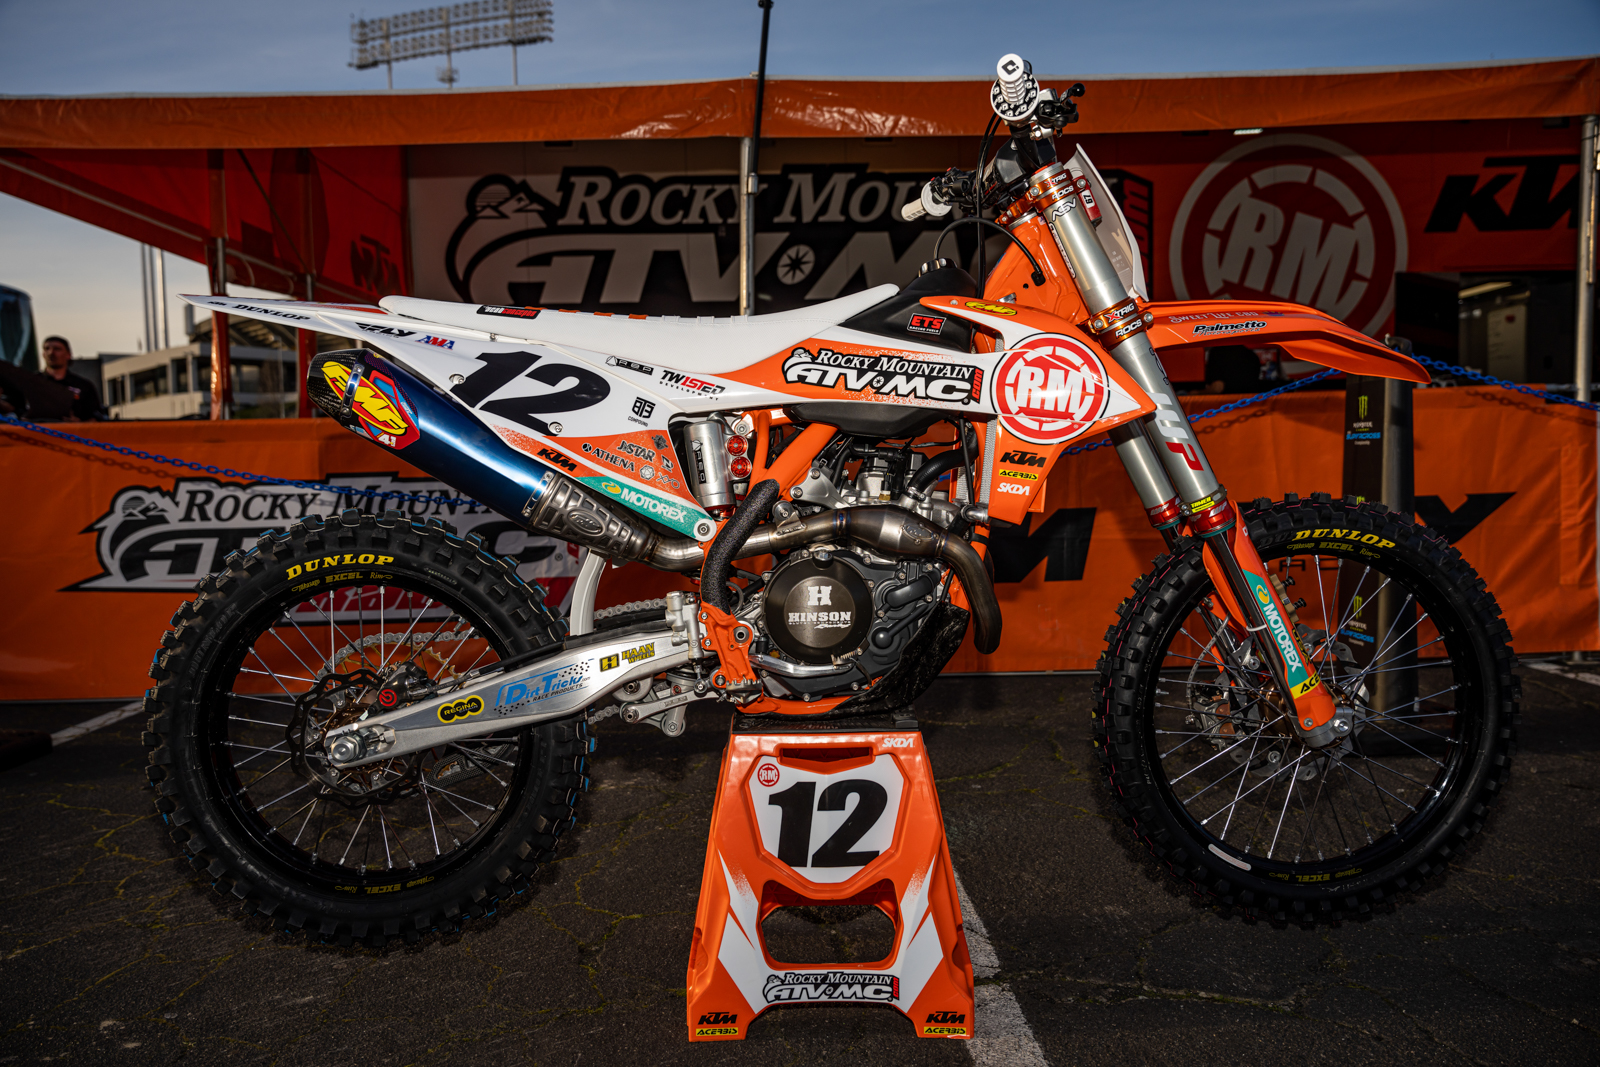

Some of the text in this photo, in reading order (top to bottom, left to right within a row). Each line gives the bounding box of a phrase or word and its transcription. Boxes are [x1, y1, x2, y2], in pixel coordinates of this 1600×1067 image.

[556, 174, 768, 227] ROCKY
[234, 304, 312, 321] DUNLOP
[1104, 303, 1135, 322] XTRIG
[356, 322, 415, 337] FLY
[911, 315, 944, 330] ETS
[1115, 318, 1144, 339] ROCS
[1192, 321, 1267, 337] Palmetto
[416, 335, 456, 350] AMA
[814, 350, 975, 384] ROCKY MOUNTAIN
[321, 363, 410, 430] FMF
[449, 351, 611, 437] 12
[537, 448, 578, 472] KTM
[591, 447, 635, 472] ATHENA
[1000, 454, 1047, 468] KTM
[997, 482, 1030, 496] SKDA
[178, 489, 322, 522] ROCKY
[619, 488, 688, 523] MOTOREX
[1291, 528, 1396, 549] DUNLOP
[1318, 541, 1355, 552] EXCEL
[285, 553, 395, 581] DUNLOP
[324, 571, 363, 584] EXCEL
[788, 611, 852, 622] HINSON
[1262, 602, 1303, 673] MOTOREX
[621, 642, 655, 660] HAAN
[628, 651, 656, 664] WHEELS
[532, 682, 584, 703] RACE PRODUCTS
[443, 700, 478, 716] REGINA
[882, 737, 914, 748] SKDA
[768, 778, 889, 868] 12
[783, 973, 893, 985] ROCKY MOUNTAIN
[697, 1011, 738, 1025] KTM
[925, 1010, 966, 1025] KTM
